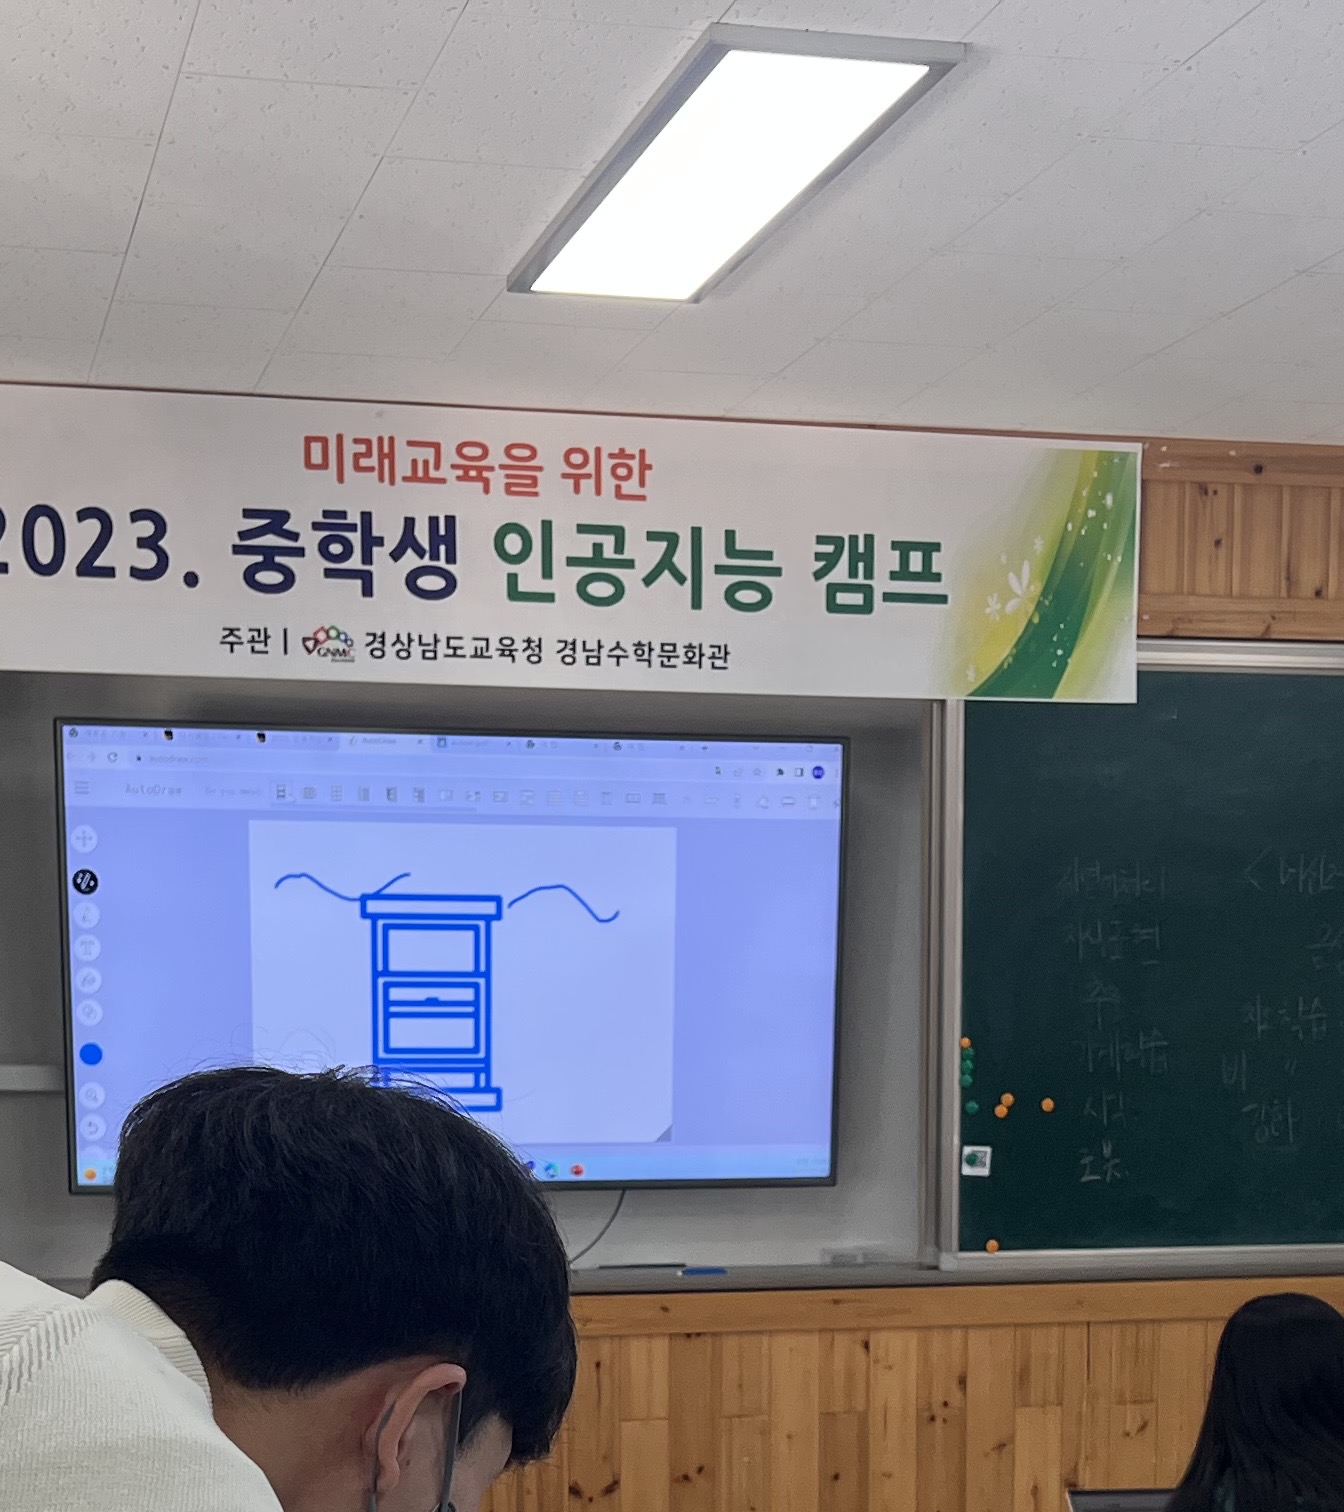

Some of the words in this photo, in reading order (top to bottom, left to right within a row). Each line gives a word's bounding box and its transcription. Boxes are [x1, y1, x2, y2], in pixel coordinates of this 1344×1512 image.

[303, 432, 544, 498] 미래교육을
[560, 446, 653, 502] 위한
[231, 507, 458, 602] 중학생
[493, 518, 784, 614] 인공지능
[812, 533, 949, 614] 캠프
[218, 626, 272, 656] 주관
[364, 630, 544, 666] 경상남도교육청
[555, 638, 733, 672] 경남수학문화관
